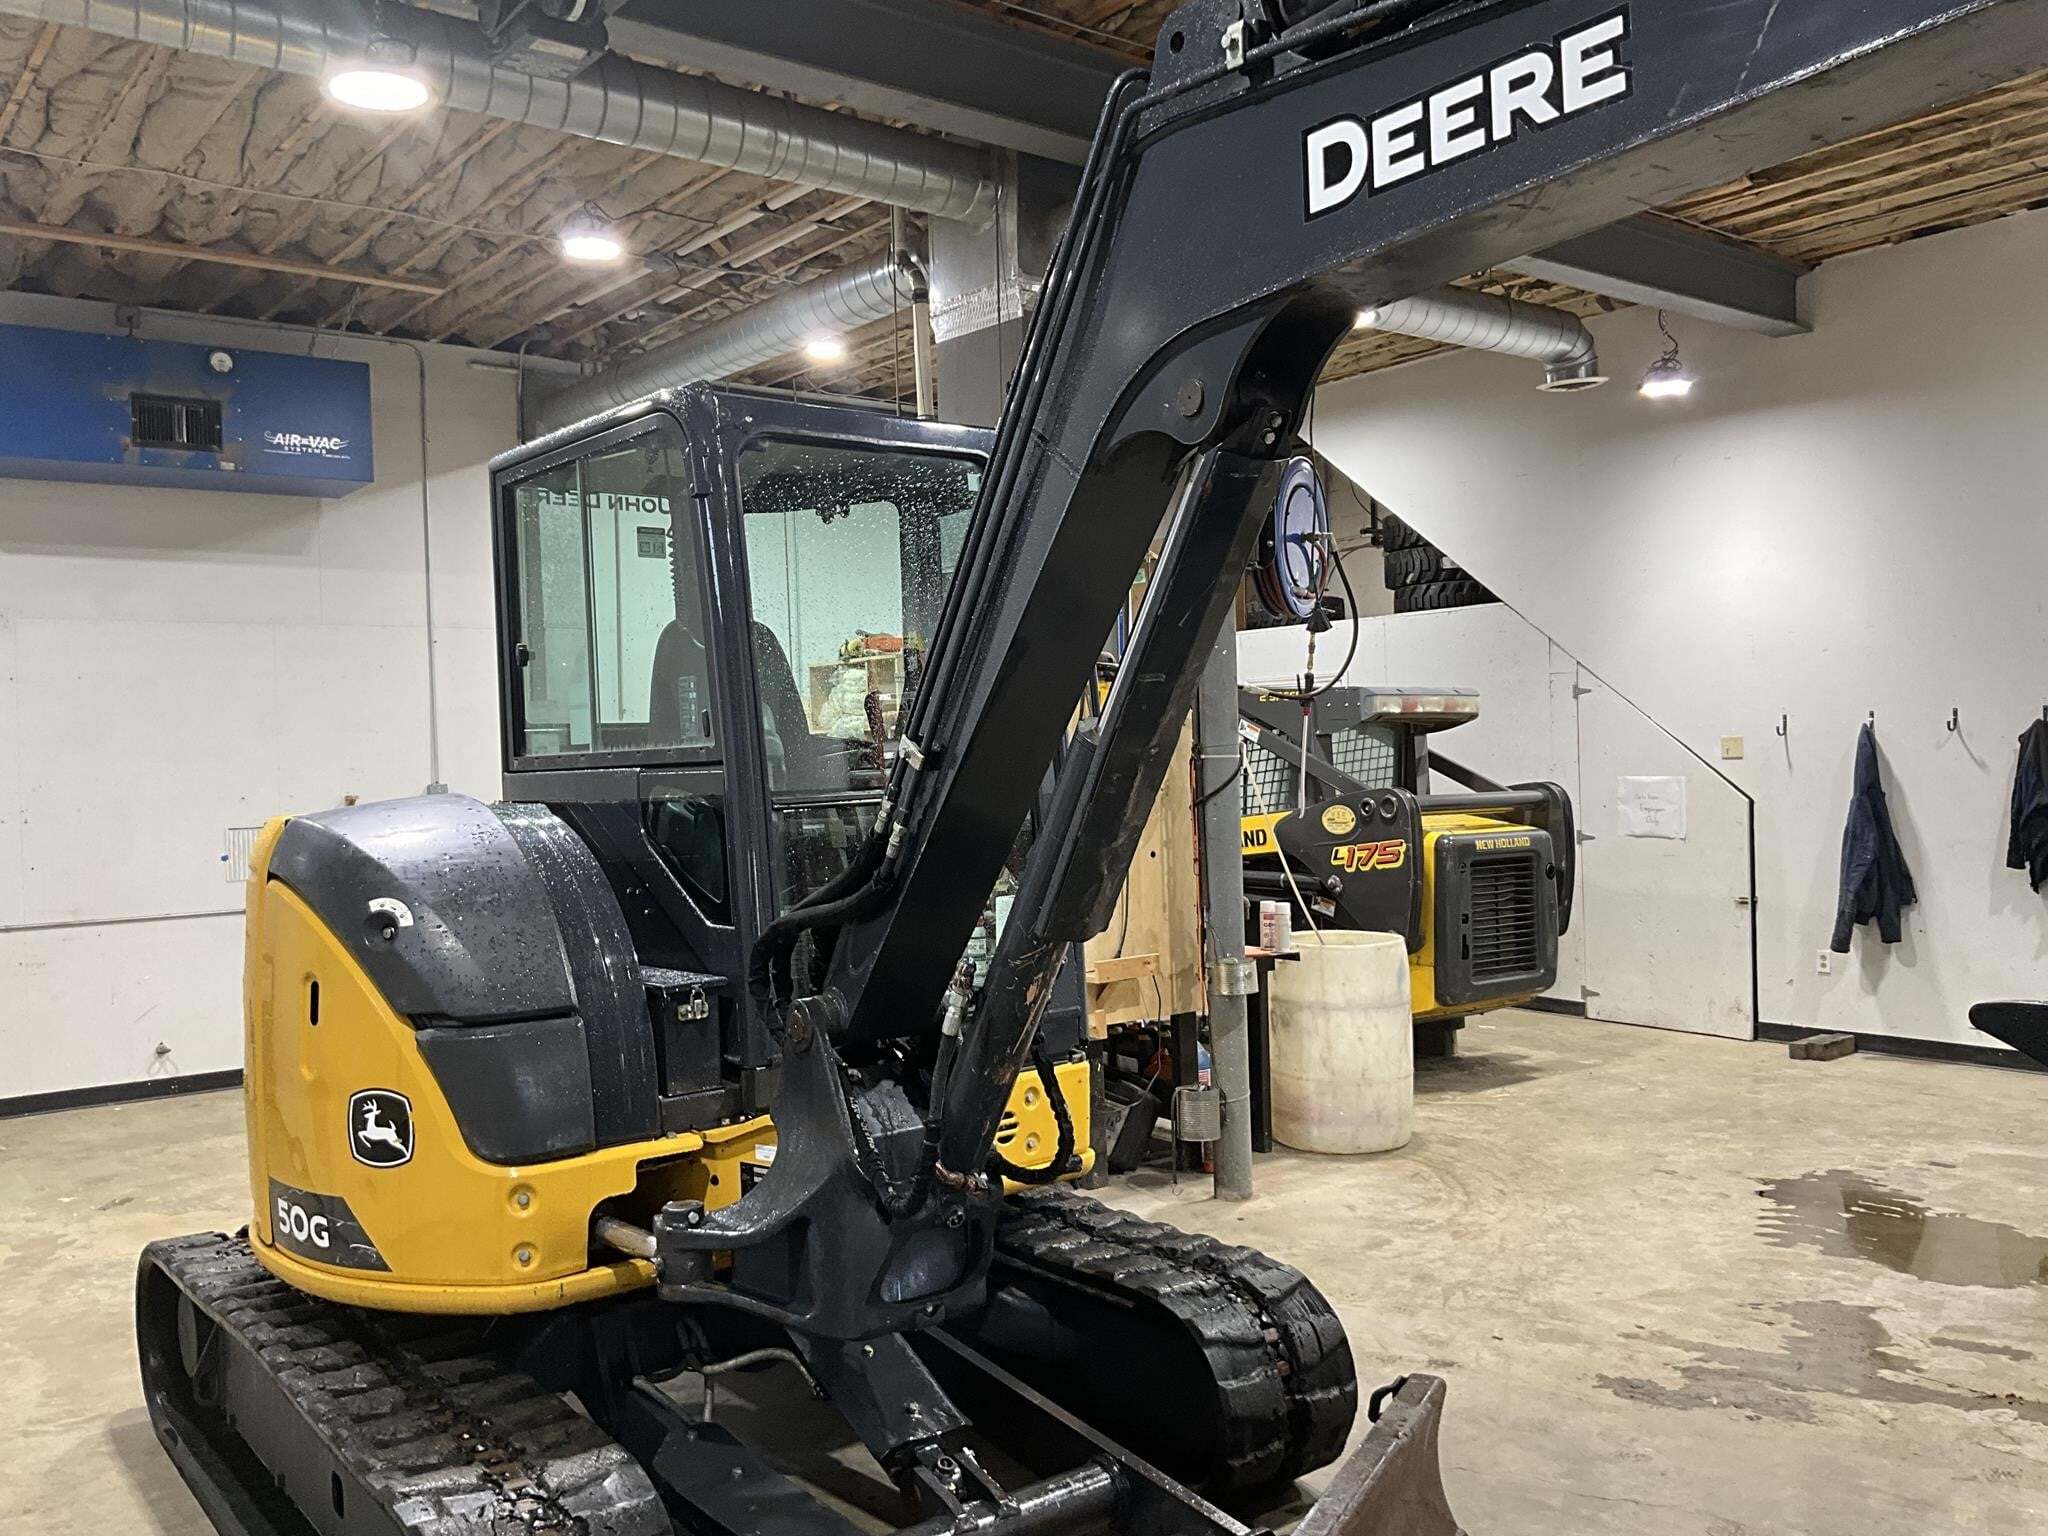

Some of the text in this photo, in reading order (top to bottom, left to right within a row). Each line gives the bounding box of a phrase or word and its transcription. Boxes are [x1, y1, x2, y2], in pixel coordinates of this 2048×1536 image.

[1307, 14, 1627, 214] DEERE
[1332, 839, 1406, 871] L175
[1475, 836, 1531, 851] NEW HOLLAND
[277, 1197, 330, 1249] 50G
